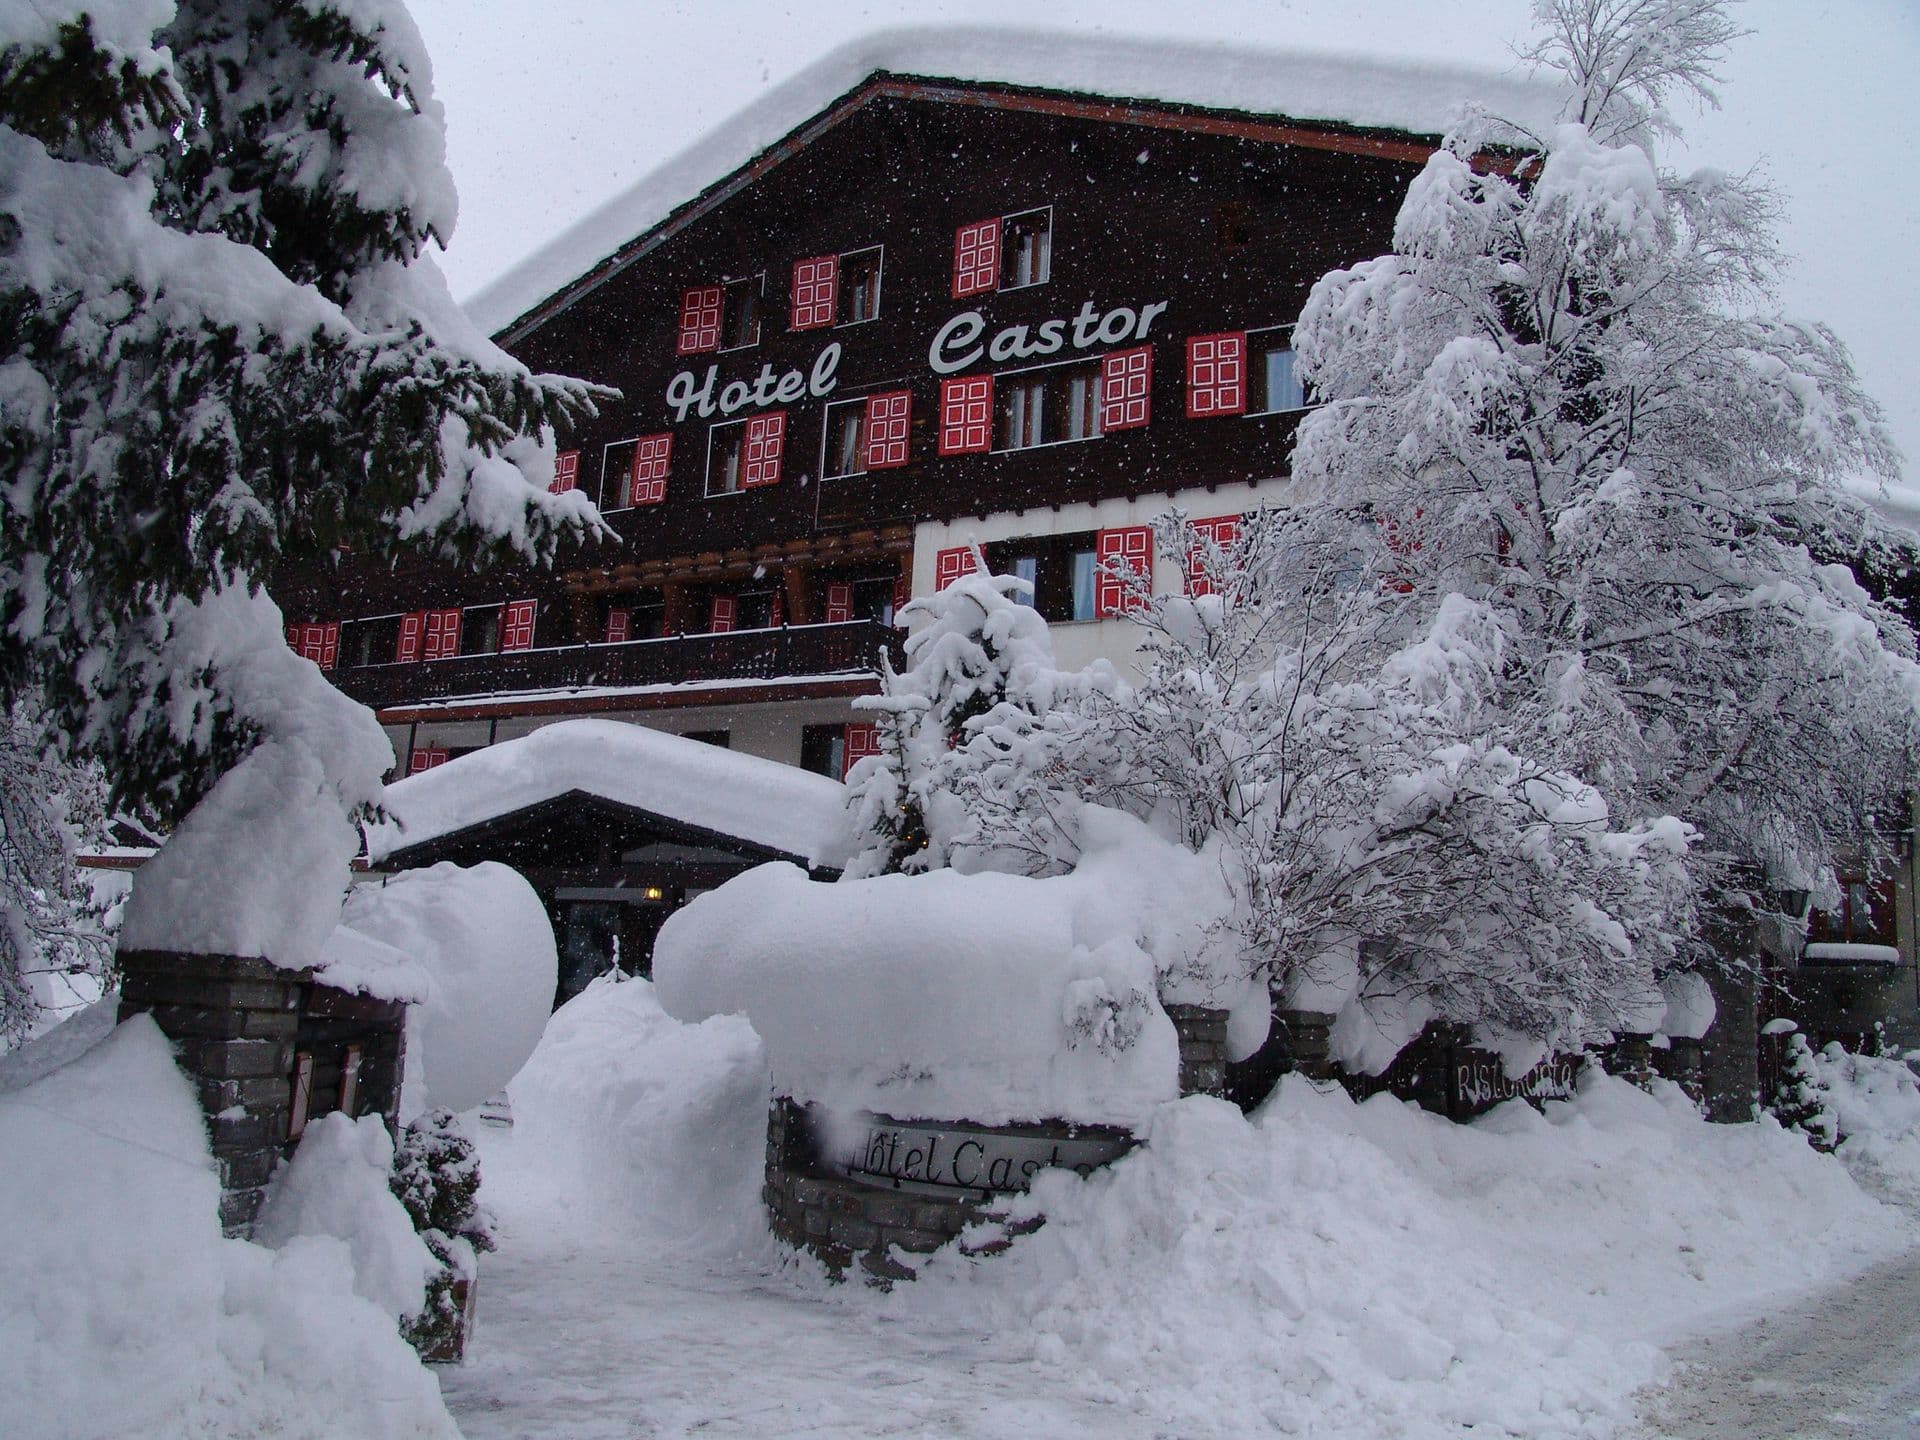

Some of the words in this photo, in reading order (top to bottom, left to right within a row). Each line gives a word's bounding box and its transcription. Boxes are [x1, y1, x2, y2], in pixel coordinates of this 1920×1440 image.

[666, 342, 842, 422] Hotel
[929, 300, 1167, 374] Castor
[952, 1140, 1112, 1190] Cast
